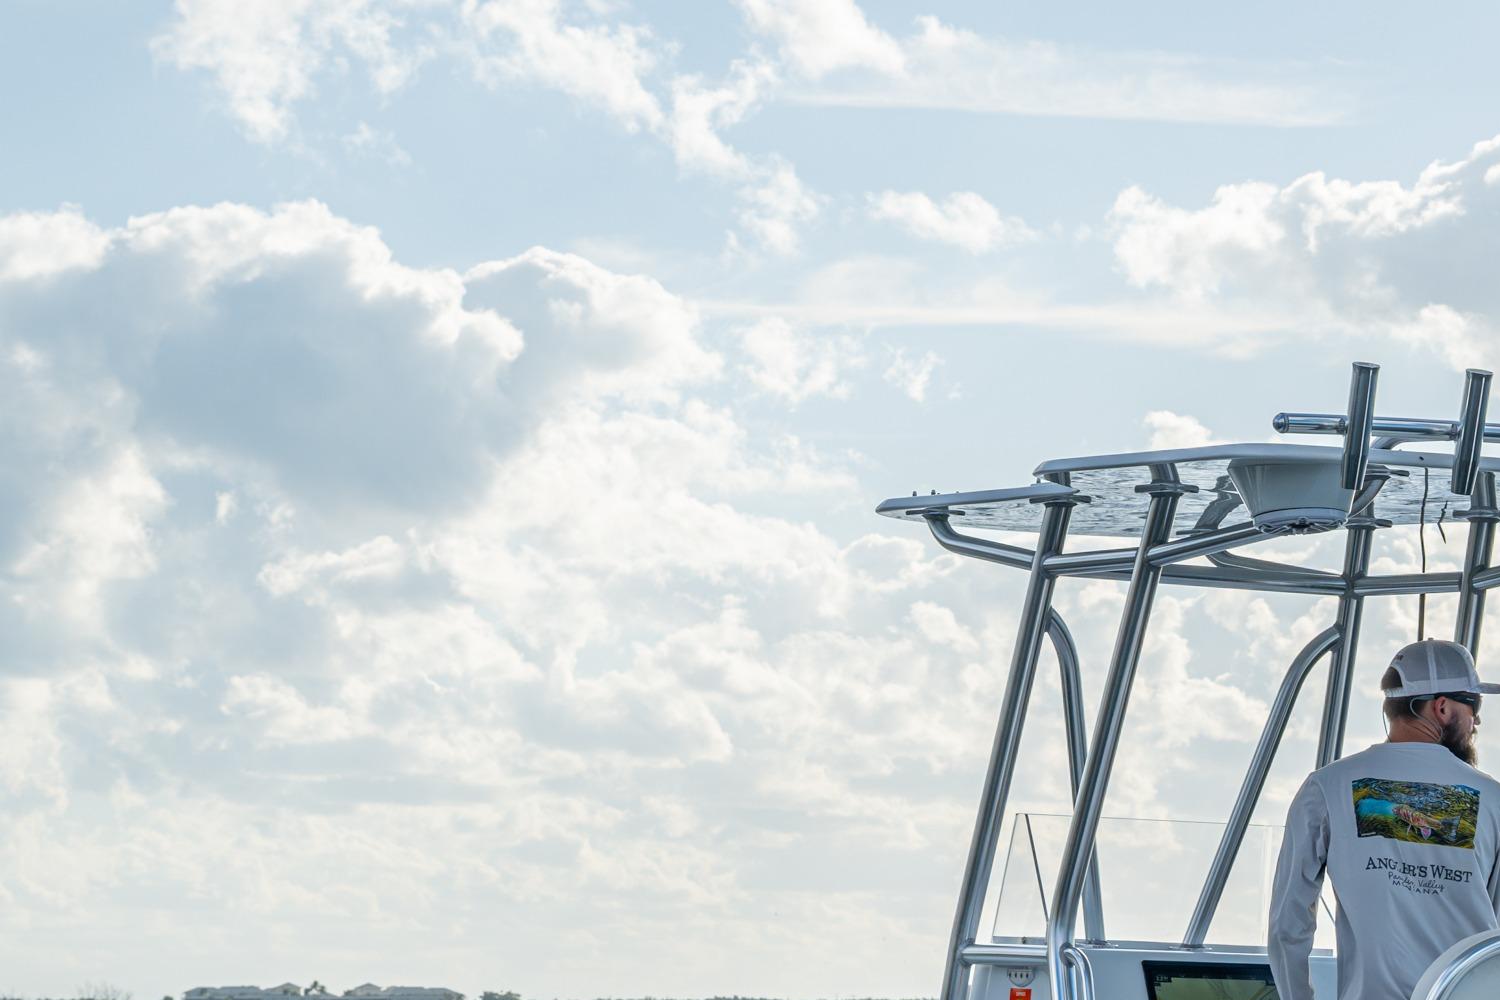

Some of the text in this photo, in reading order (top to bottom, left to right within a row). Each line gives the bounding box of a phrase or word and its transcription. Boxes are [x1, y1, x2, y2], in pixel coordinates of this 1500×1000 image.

[1365, 856, 1473, 883] ANGER'S WEST
[1392, 880, 1440, 895] MONANA
[1418, 879, 1445, 892] Valley
